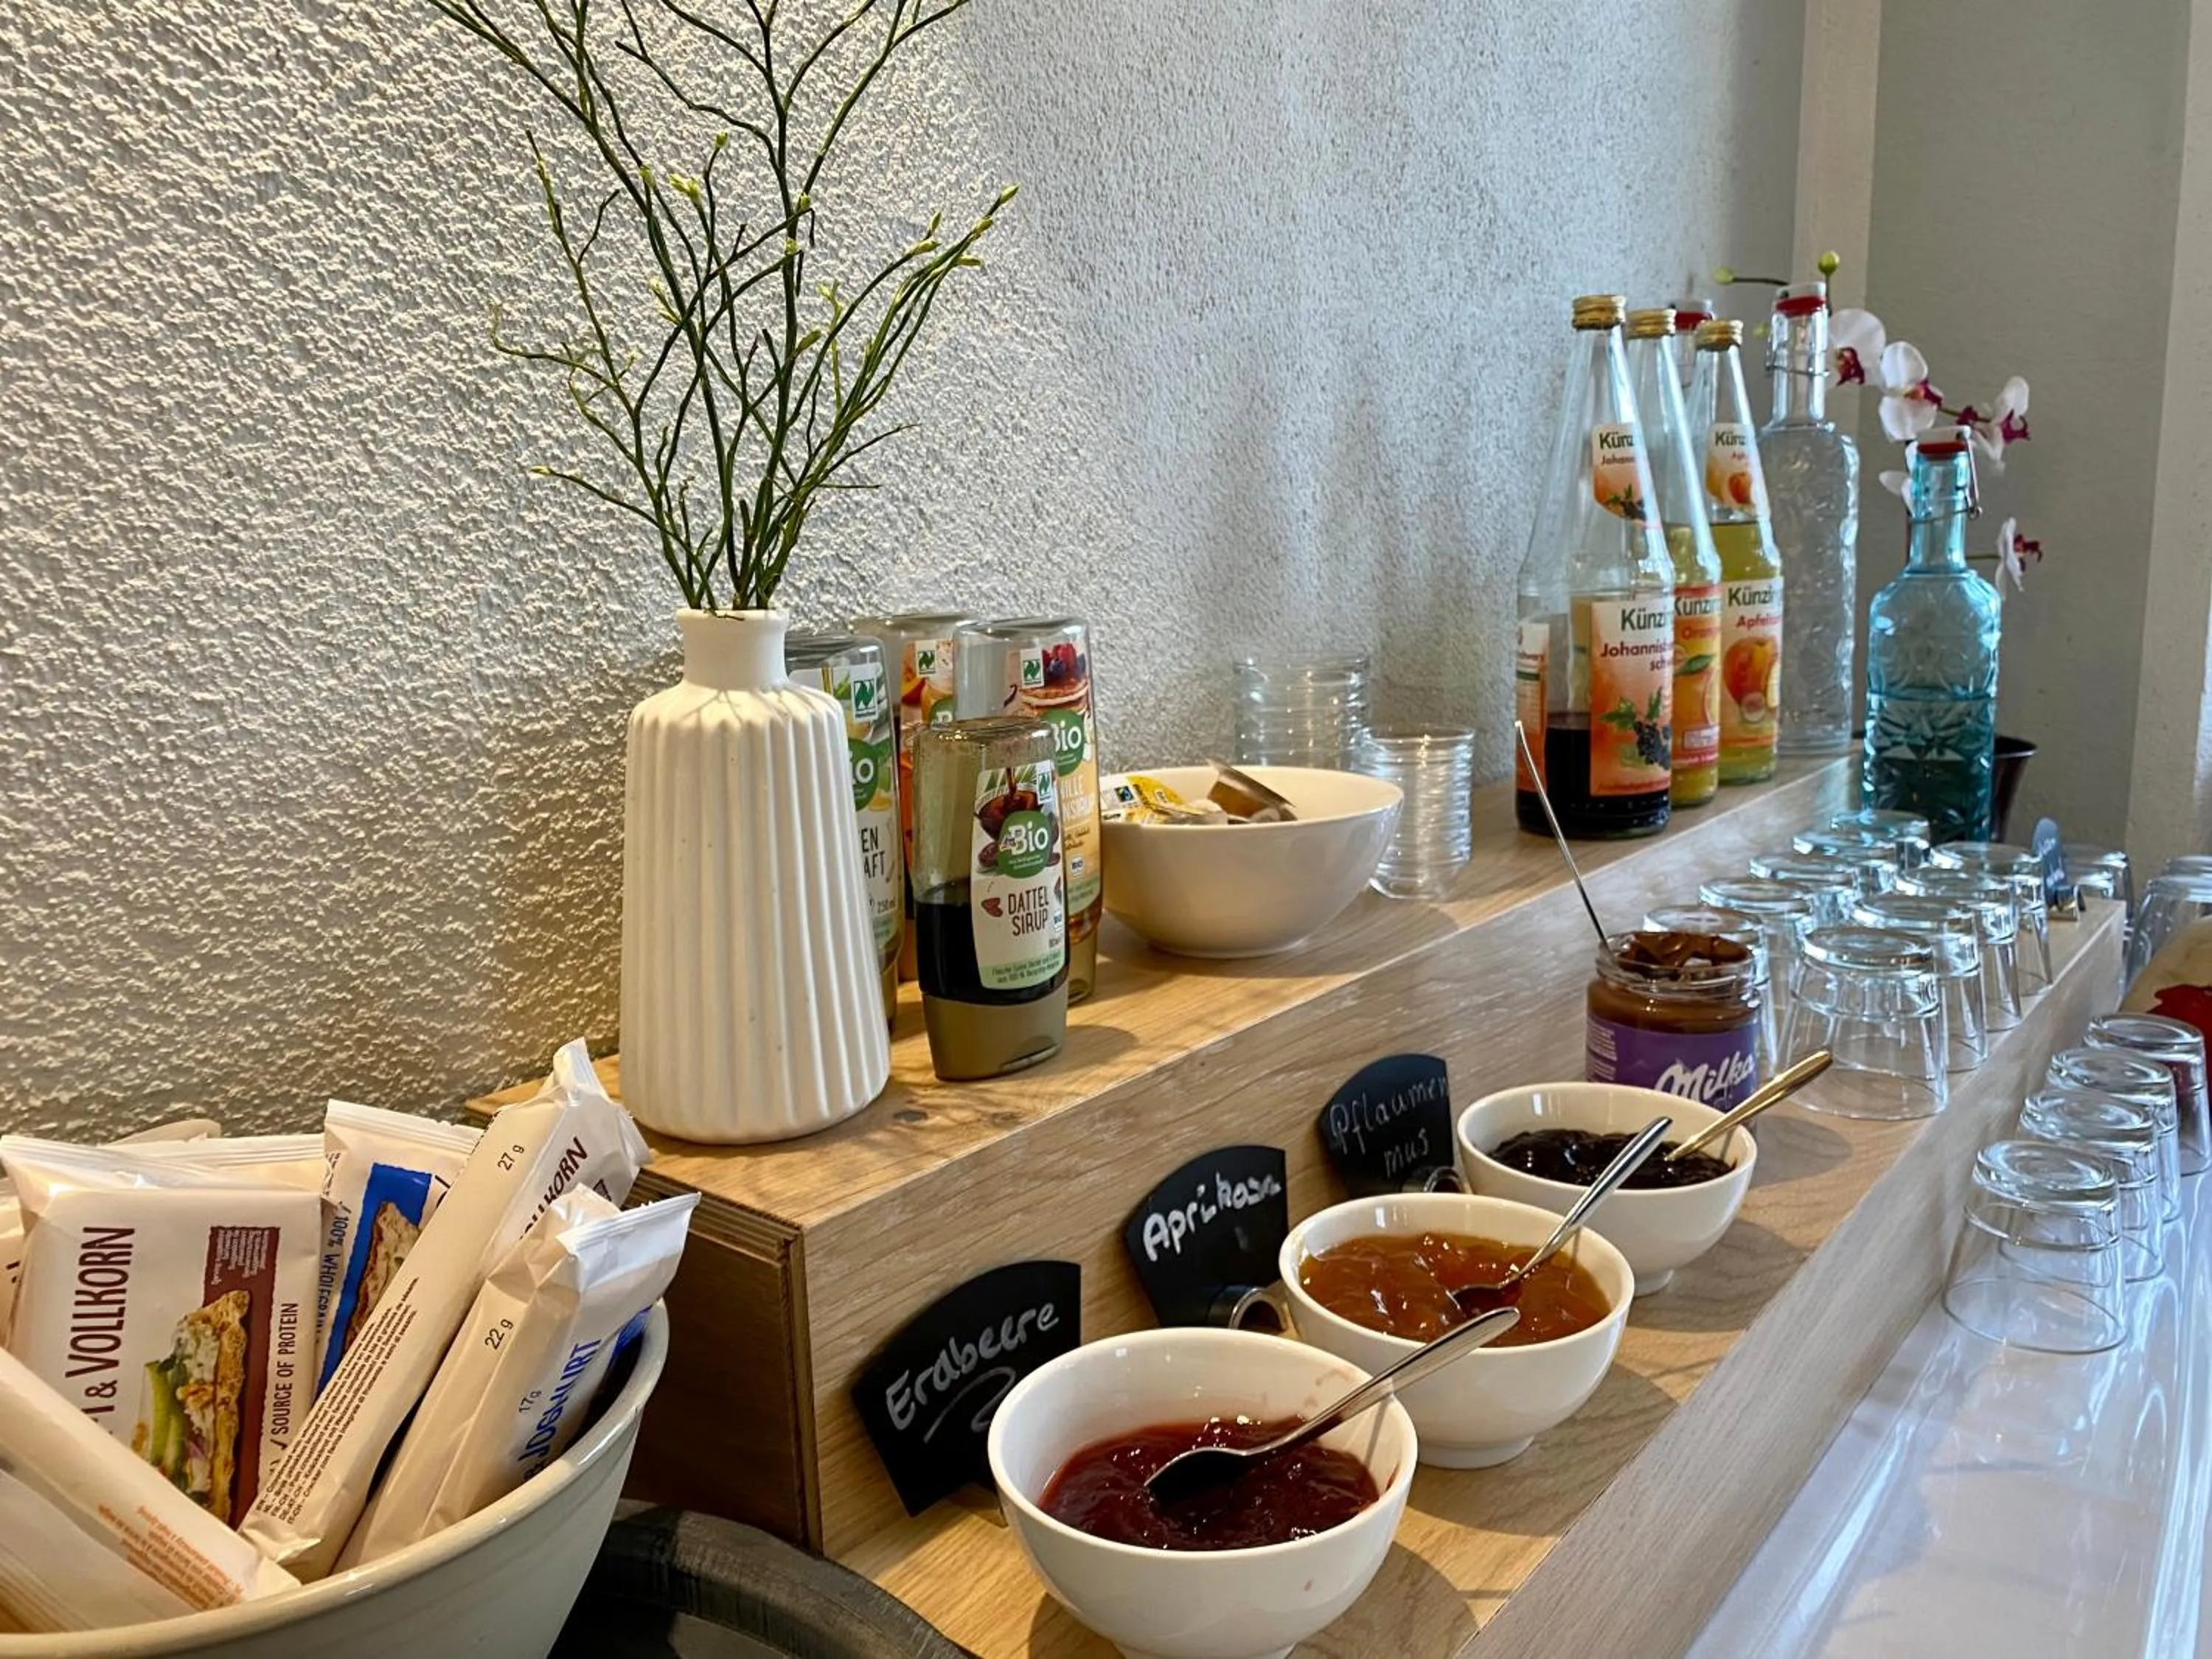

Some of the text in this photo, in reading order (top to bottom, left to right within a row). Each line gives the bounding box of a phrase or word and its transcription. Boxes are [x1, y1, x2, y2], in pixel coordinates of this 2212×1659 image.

[1599, 431, 1634, 449] Künz
[1715, 431, 1746, 445] Künz
[859, 825, 879, 853] EN
[1008, 886, 1049, 915] DATTEL
[1012, 907, 1048, 937] SIRUP
[1654, 1050, 1755, 1102] Milka
[498, 1155, 515, 1171] 27
[1384, 1128, 1430, 1177] mus
[332, 1214, 349, 1252] 100%
[65, 1226, 135, 1380] VOLLKORN
[278, 1302, 299, 1353] PROTEIN
[484, 1329, 505, 1351] 22
[275, 1359, 293, 1381] OF
[886, 1303, 1059, 1431] Erdbeere
[269, 1385, 293, 1436] SOURCE
[518, 1338, 602, 1464] JOGHURT
